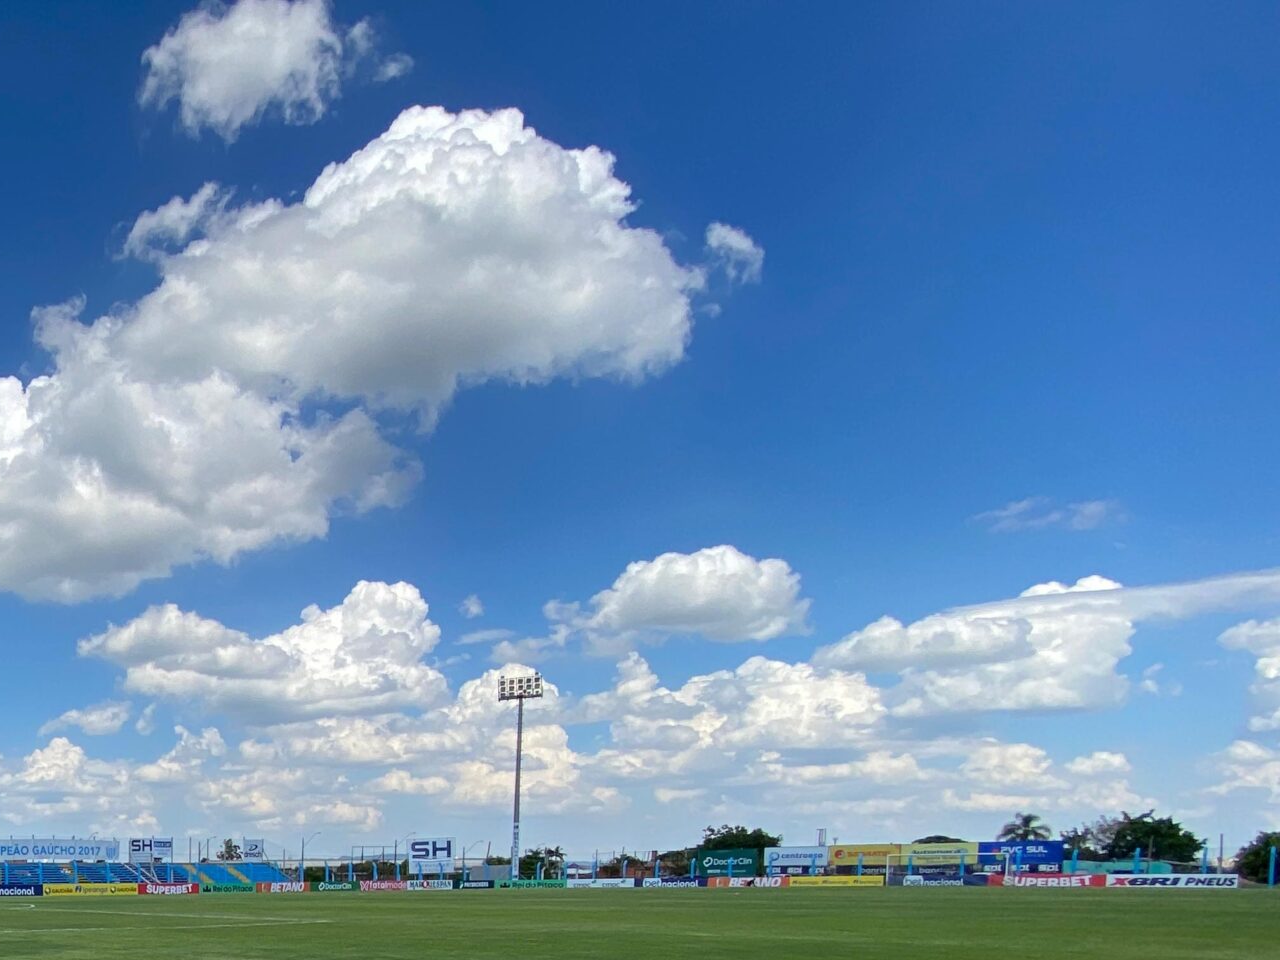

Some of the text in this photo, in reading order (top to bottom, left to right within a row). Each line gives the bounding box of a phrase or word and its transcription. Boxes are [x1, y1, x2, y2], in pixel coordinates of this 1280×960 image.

[32, 843, 76, 855] GAÚCHO
[79, 846, 100, 855] 2017
[132, 839, 152, 852] SH
[411, 840, 451, 859] SH
[271, 882, 304, 892] BETANO
[1003, 875, 1092, 887] SUPERBET
[1110, 877, 1236, 886] XBRI PNEUS
[146, 884, 193, 894] SUPERBET
